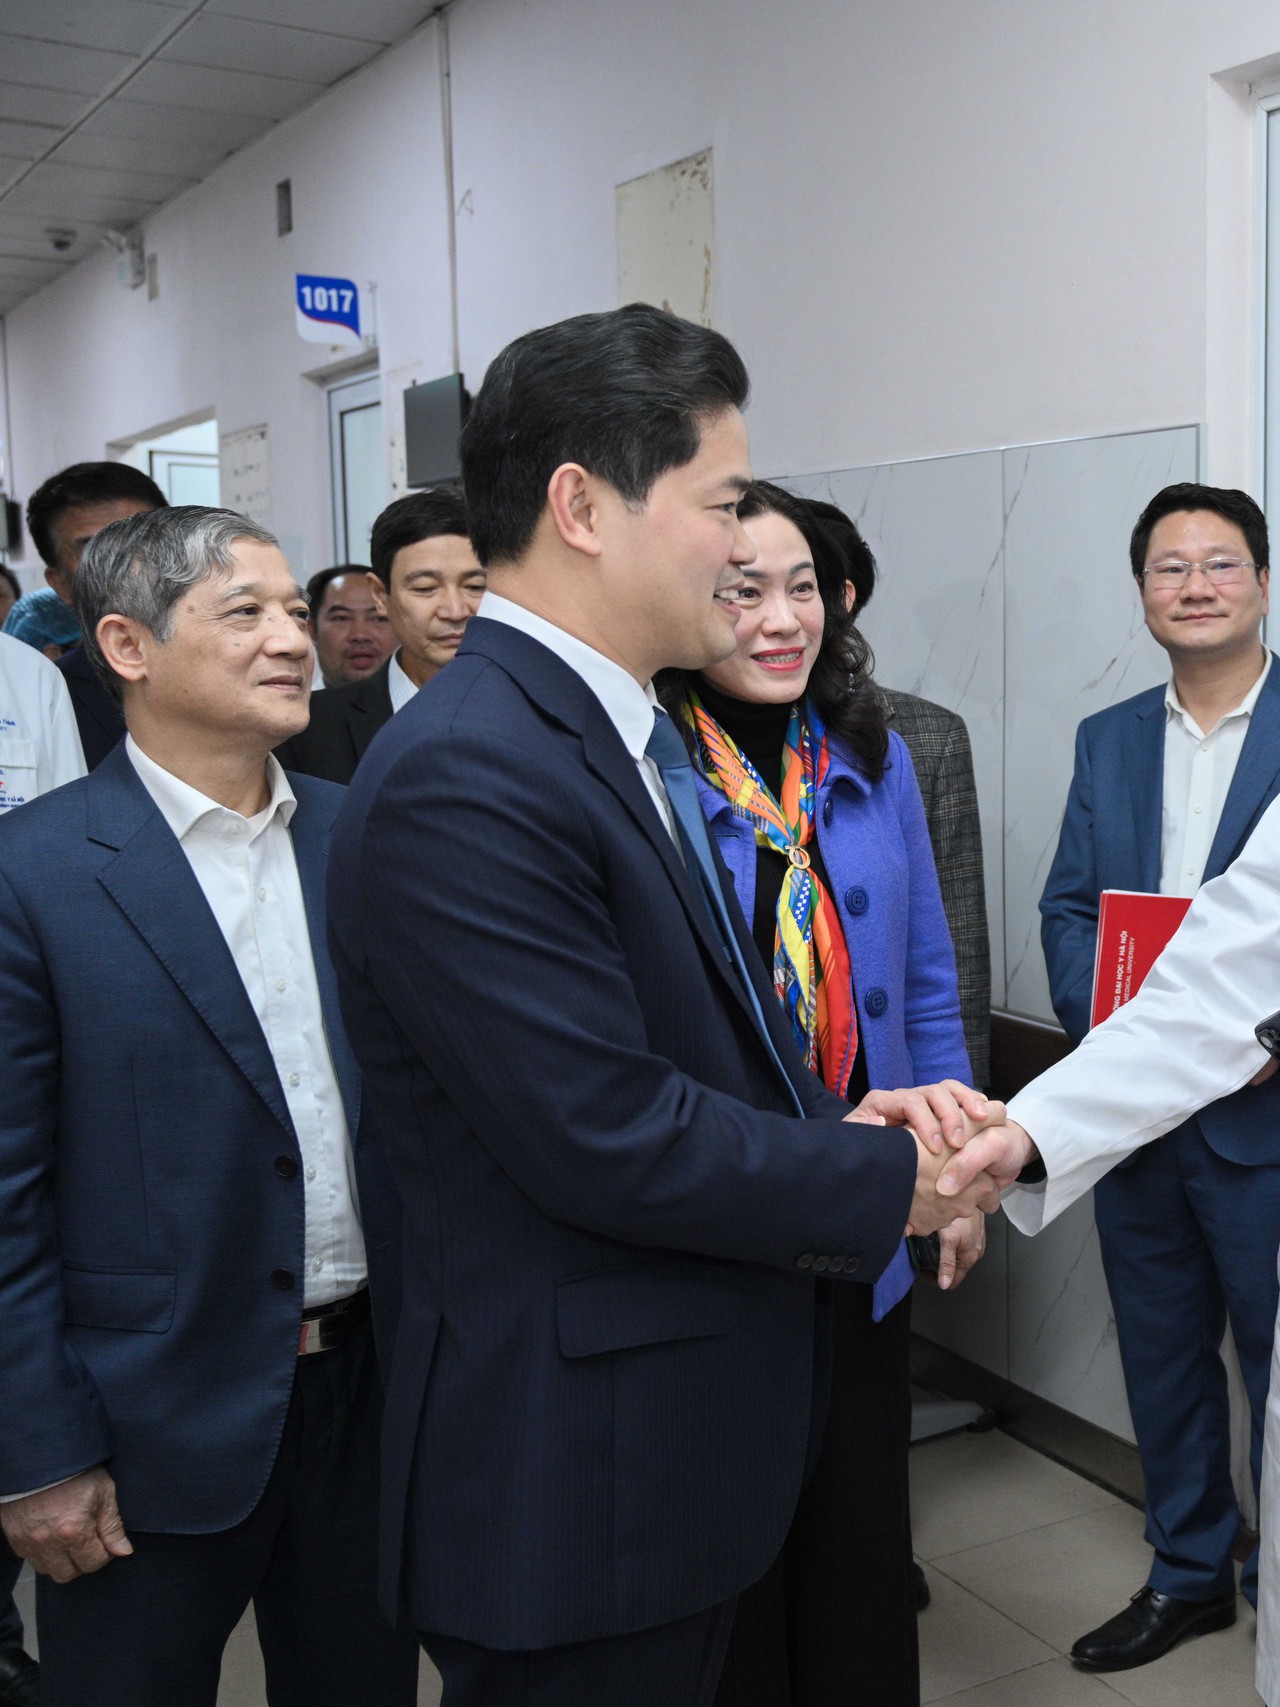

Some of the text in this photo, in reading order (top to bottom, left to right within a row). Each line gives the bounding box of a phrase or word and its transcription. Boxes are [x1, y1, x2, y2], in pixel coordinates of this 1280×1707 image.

[300, 285, 354, 313] 1017
[1124, 937, 1136, 1002] MEDICAL UNIVERSITY
